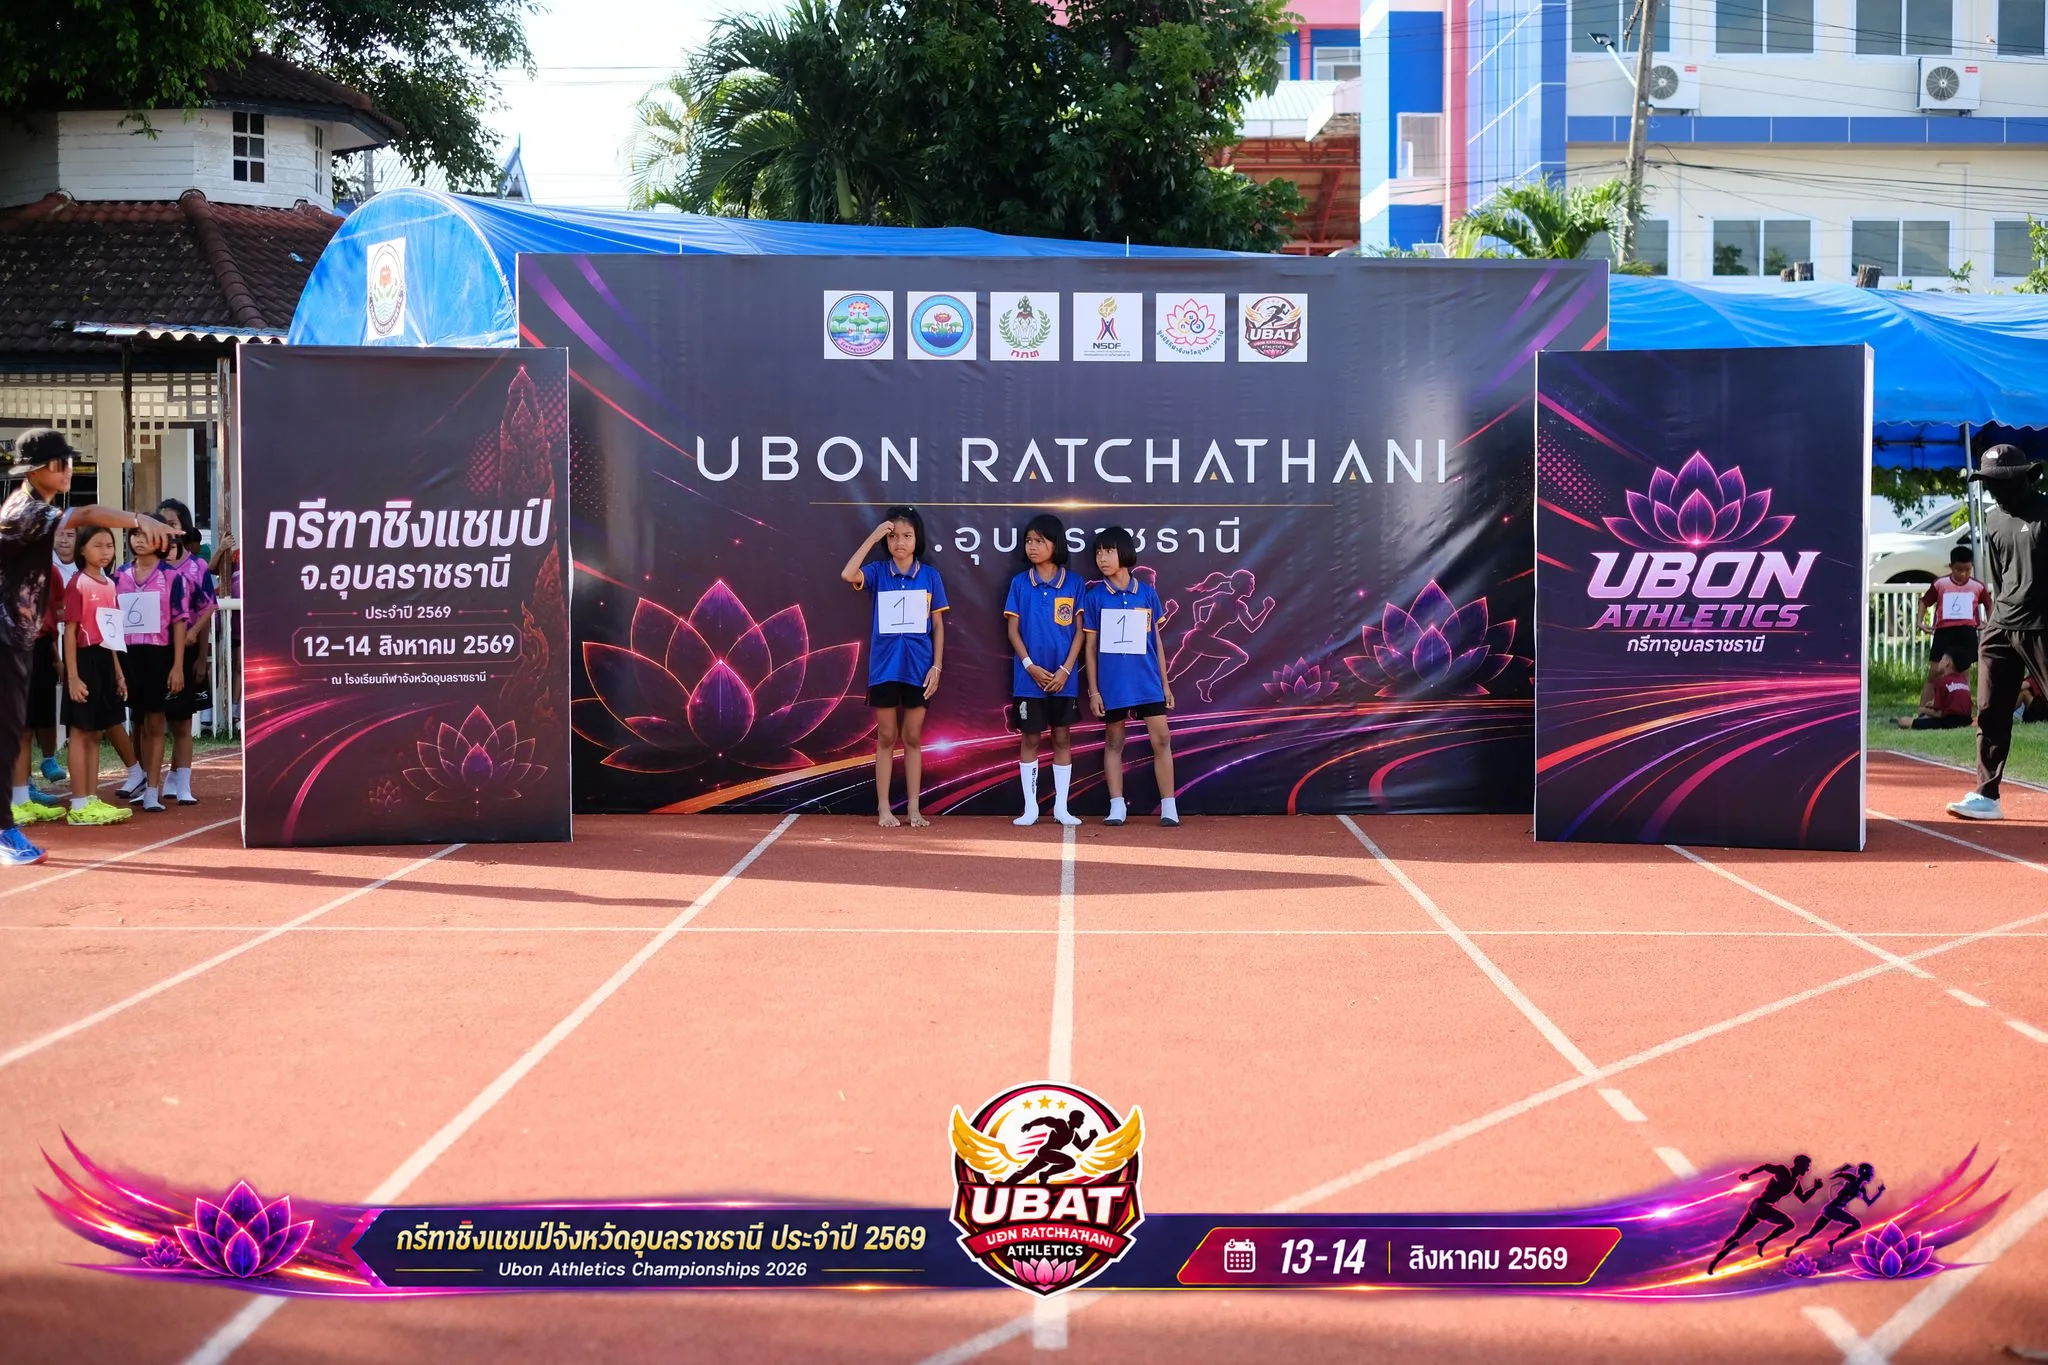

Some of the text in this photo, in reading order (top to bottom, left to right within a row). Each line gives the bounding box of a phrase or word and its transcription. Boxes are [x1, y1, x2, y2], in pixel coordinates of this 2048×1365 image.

[1092, 342, 1122, 350] NSDF
[1250, 328, 1297, 340] UBAT
[1010, 349, 1040, 358] กกท
[697, 435, 1446, 484] UBON RATCHATHANI
[265, 498, 553, 549] กรีฑาชิงแชมป์
[300, 554, 512, 600] จ.อุบลราชธานี
[1587, 551, 1822, 599] UBON
[127, 597, 143, 624] 6
[365, 605, 452, 620] ประจำปี 2569
[890, 595, 915, 626] 1
[1593, 604, 1808, 629] ATHLETICS
[1951, 596, 1961, 613] 6
[1112, 614, 1134, 644] 1
[378, 633, 456, 656] สิงหาคม
[463, 634, 515, 655] 2569
[1626, 634, 1766, 657] กรีฑาอุบลราชธานี
[331, 671, 486, 686] ณ โรงเรียนกีฬาจังหวัดอุบลราชธานี
